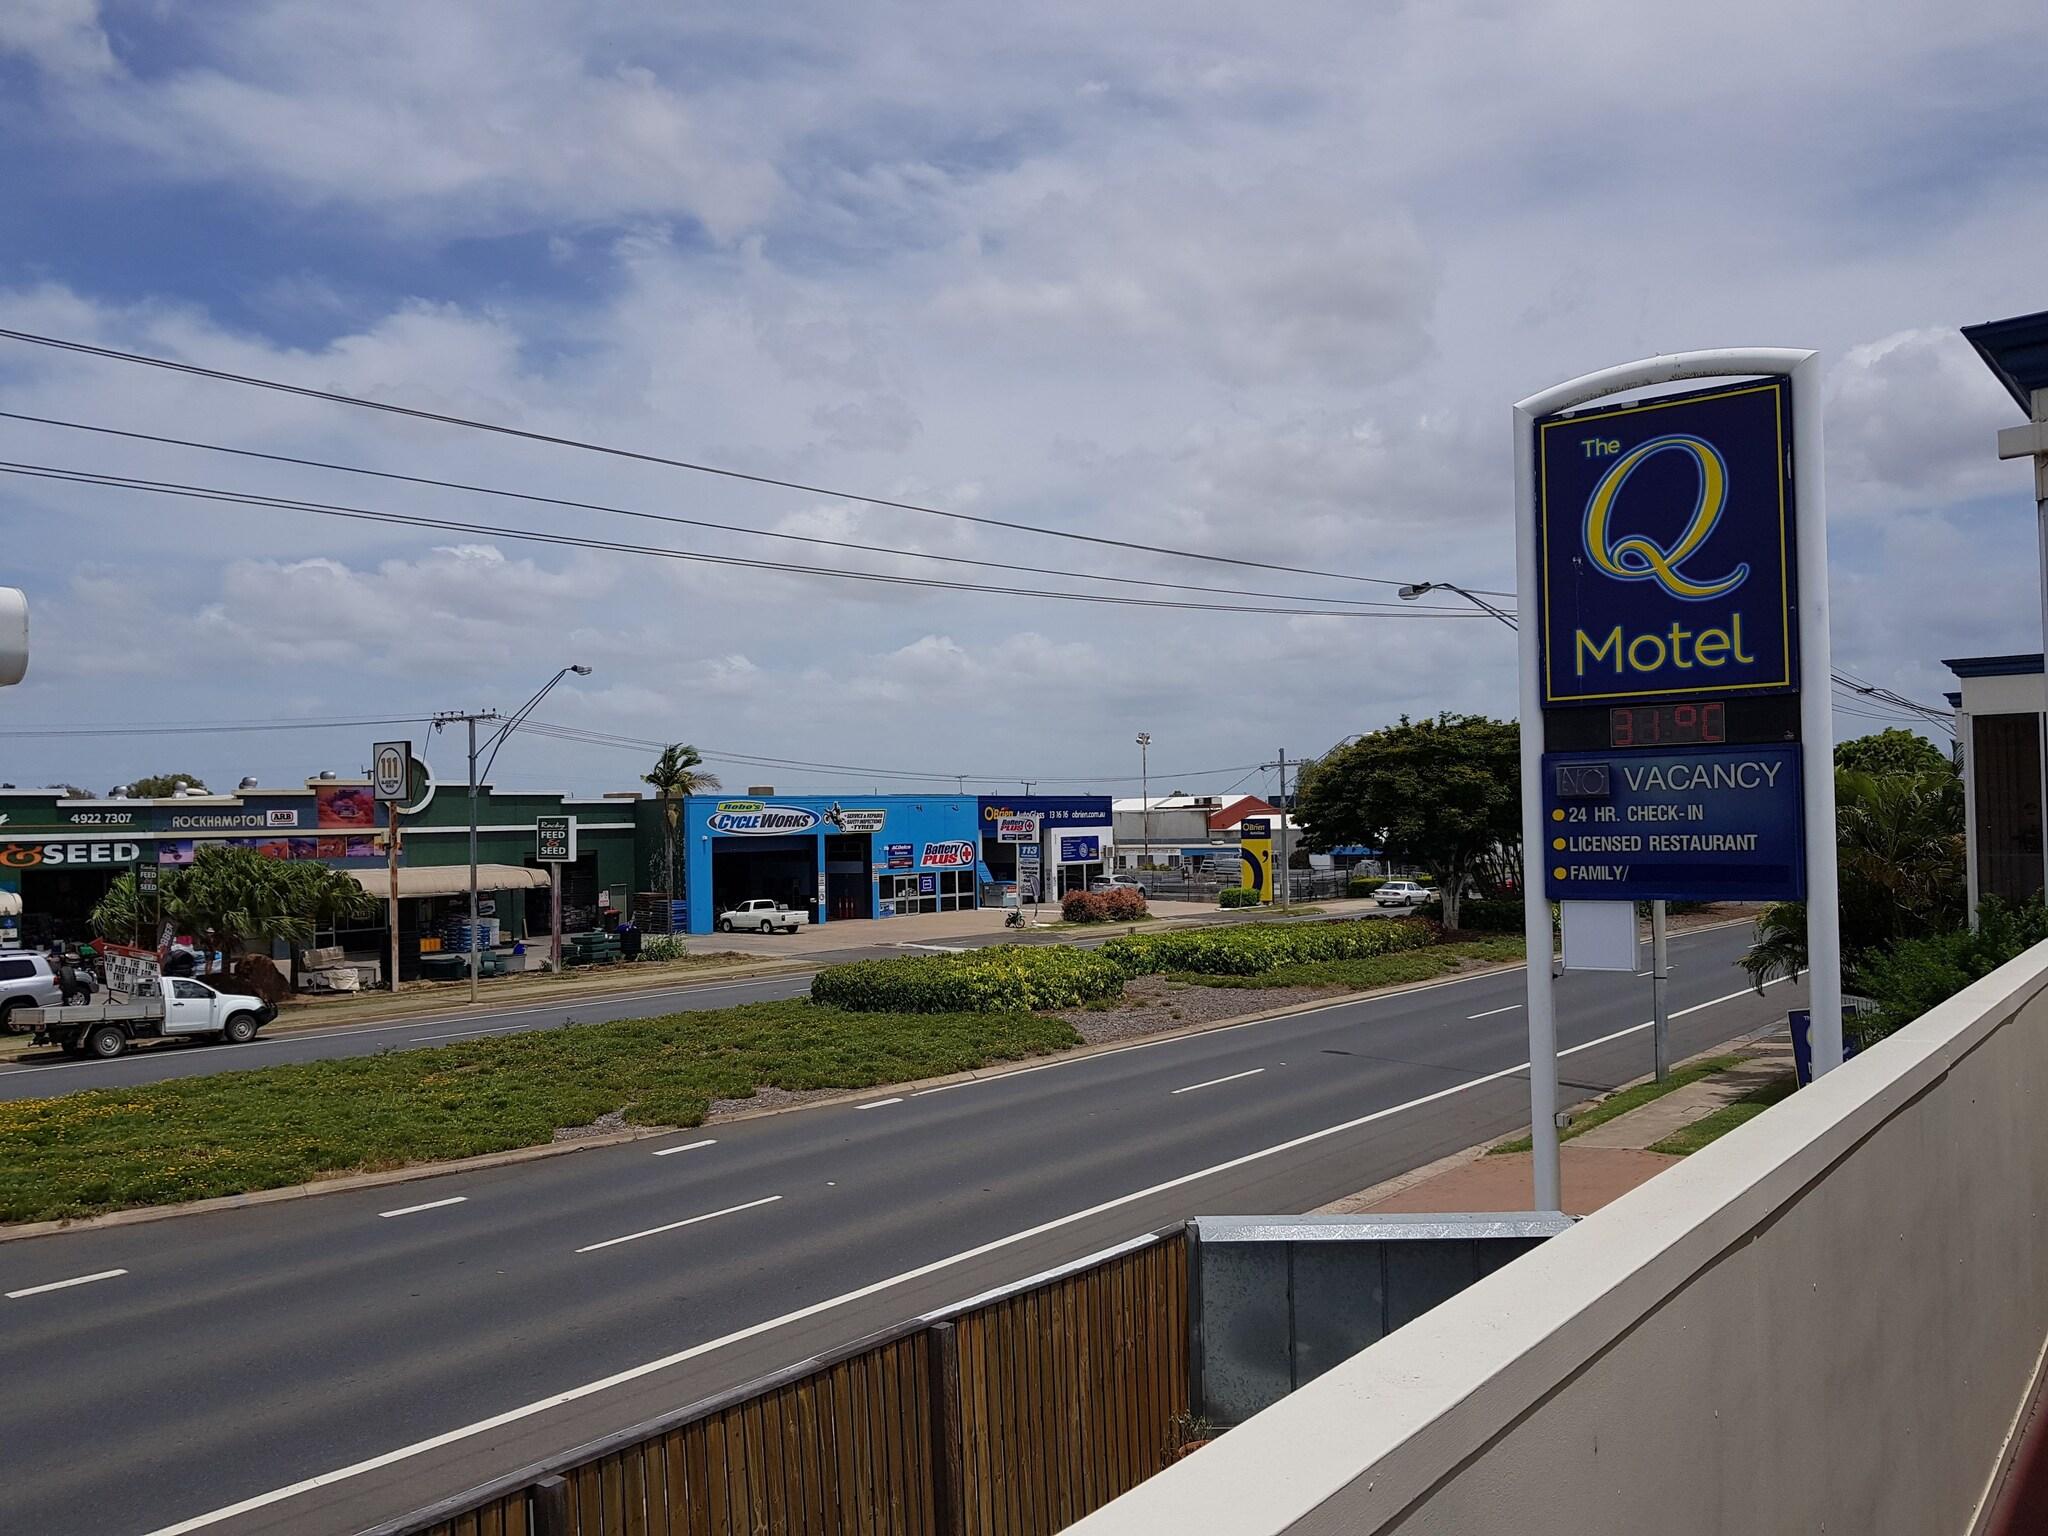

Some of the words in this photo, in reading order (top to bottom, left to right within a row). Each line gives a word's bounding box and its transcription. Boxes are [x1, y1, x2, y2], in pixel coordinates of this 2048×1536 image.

[1581, 437, 1621, 458] The
[1582, 433, 1750, 602] Q
[1574, 612, 1755, 677] Motel
[381, 757, 398, 779] 111
[1623, 761, 1783, 792] VACANCY
[70, 813, 102, 824] 4922
[104, 813, 133, 824] 7307
[172, 815, 265, 828] ROCKHAMPTON
[273, 813, 292, 821] ARB
[1568, 806, 1588, 823] 24
[1595, 806, 1621, 822] HR.
[1627, 804, 1704, 822] CHECK-IN
[541, 821, 567, 831] Rocky
[541, 831, 566, 839] FEED
[541, 846, 566, 855] SEED
[924, 843, 961, 855] Battery
[1569, 835, 1642, 853] LICENSED
[1649, 834, 1758, 852] RESTAURANT
[43, 843, 140, 864] SEED
[922, 854, 958, 865] PLUS
[140, 871, 157, 879] FEED
[1570, 864, 1630, 882] FAMILY/
[115, 964, 139, 977] PREPARE
[145, 961, 158, 971] TIME
